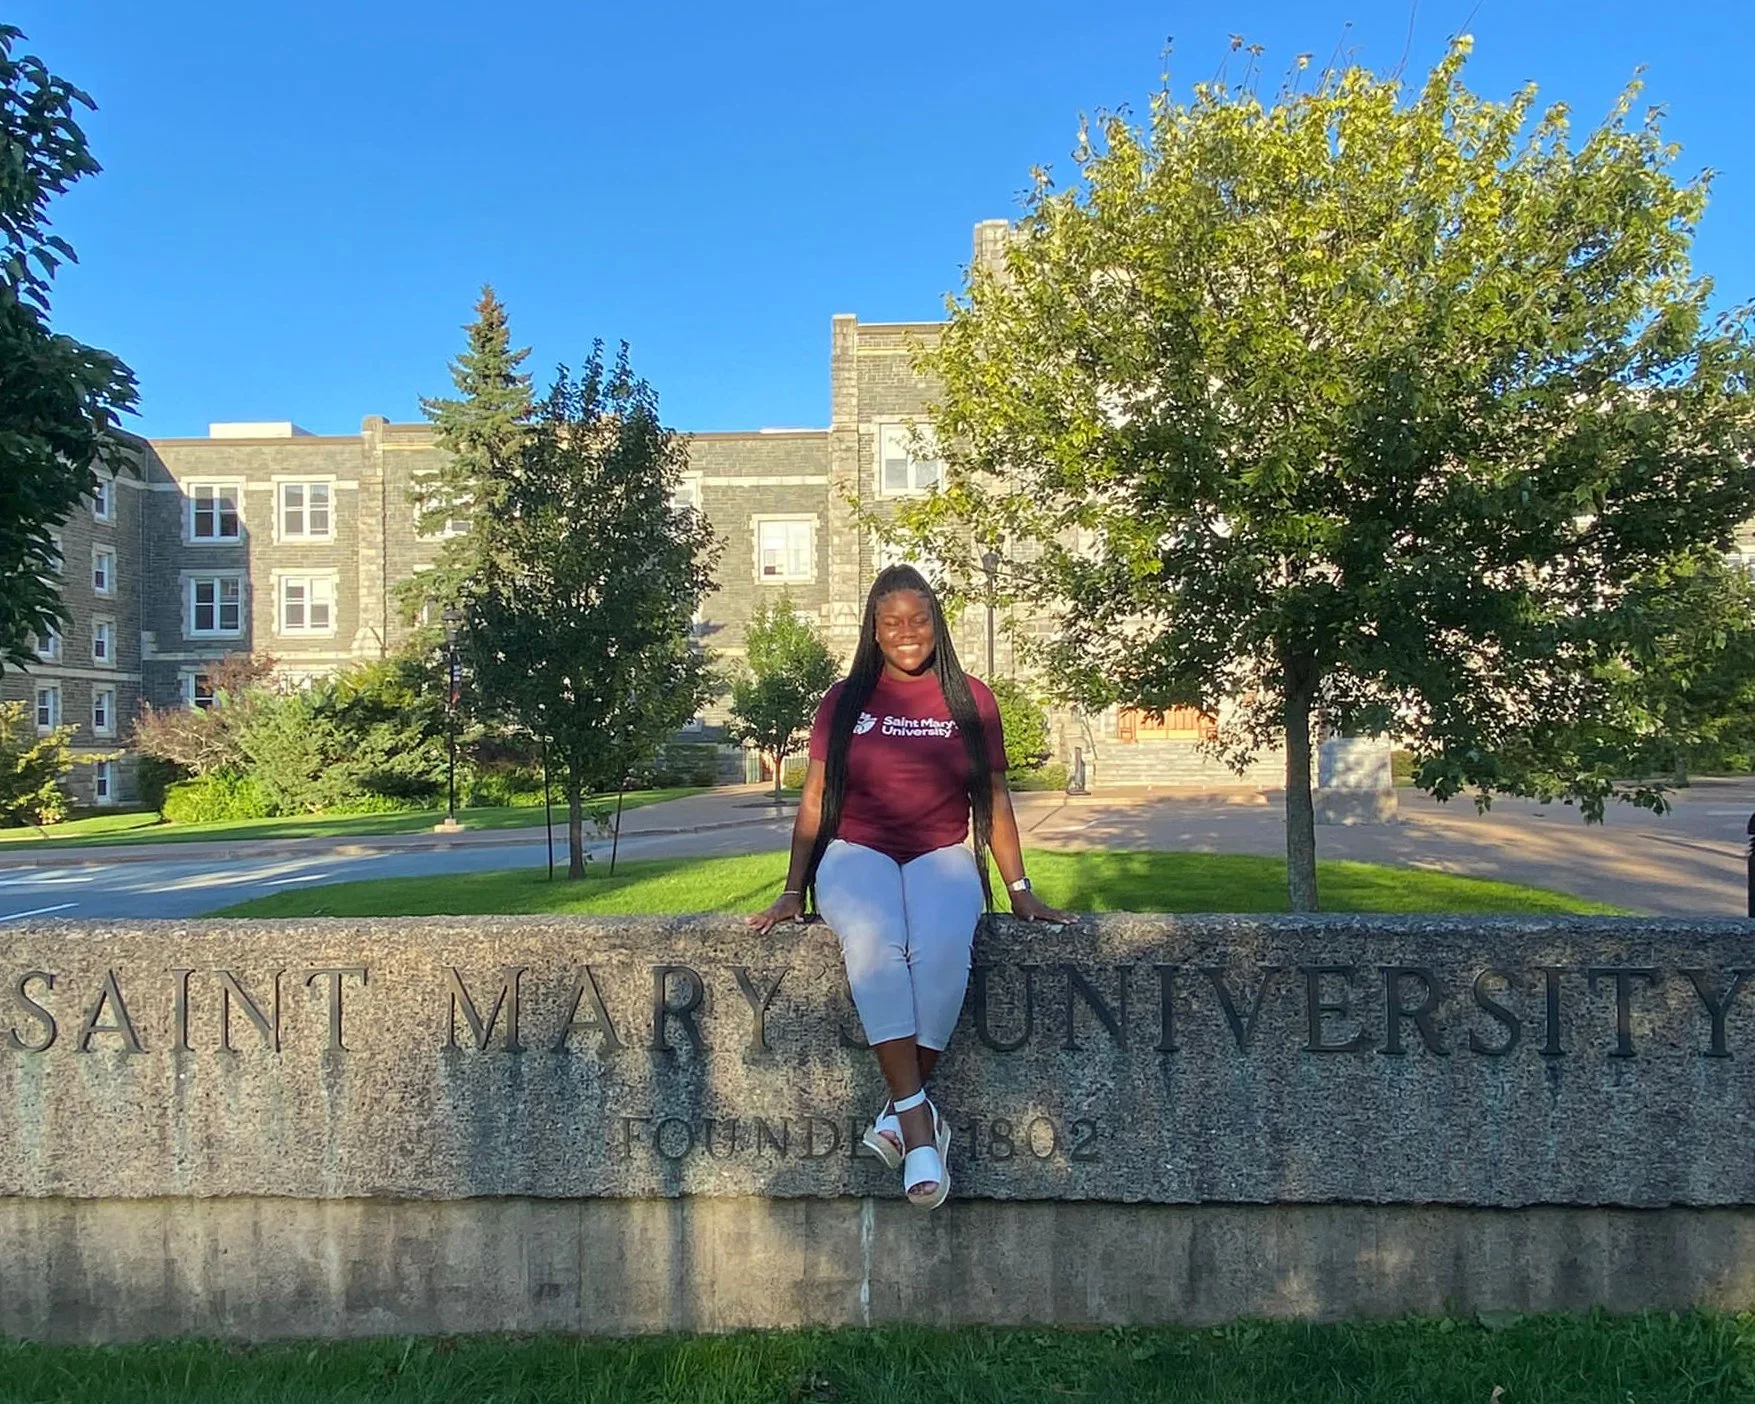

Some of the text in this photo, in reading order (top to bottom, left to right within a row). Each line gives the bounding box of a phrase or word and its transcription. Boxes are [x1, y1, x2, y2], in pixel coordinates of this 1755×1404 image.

[882, 725, 951, 738] University
[883, 716, 959, 729] Saint Mary'
[8, 964, 1755, 1058] SAINT MARY' UNIVERSITY
[619, 1115, 1098, 1162] FOUNDE 1802
